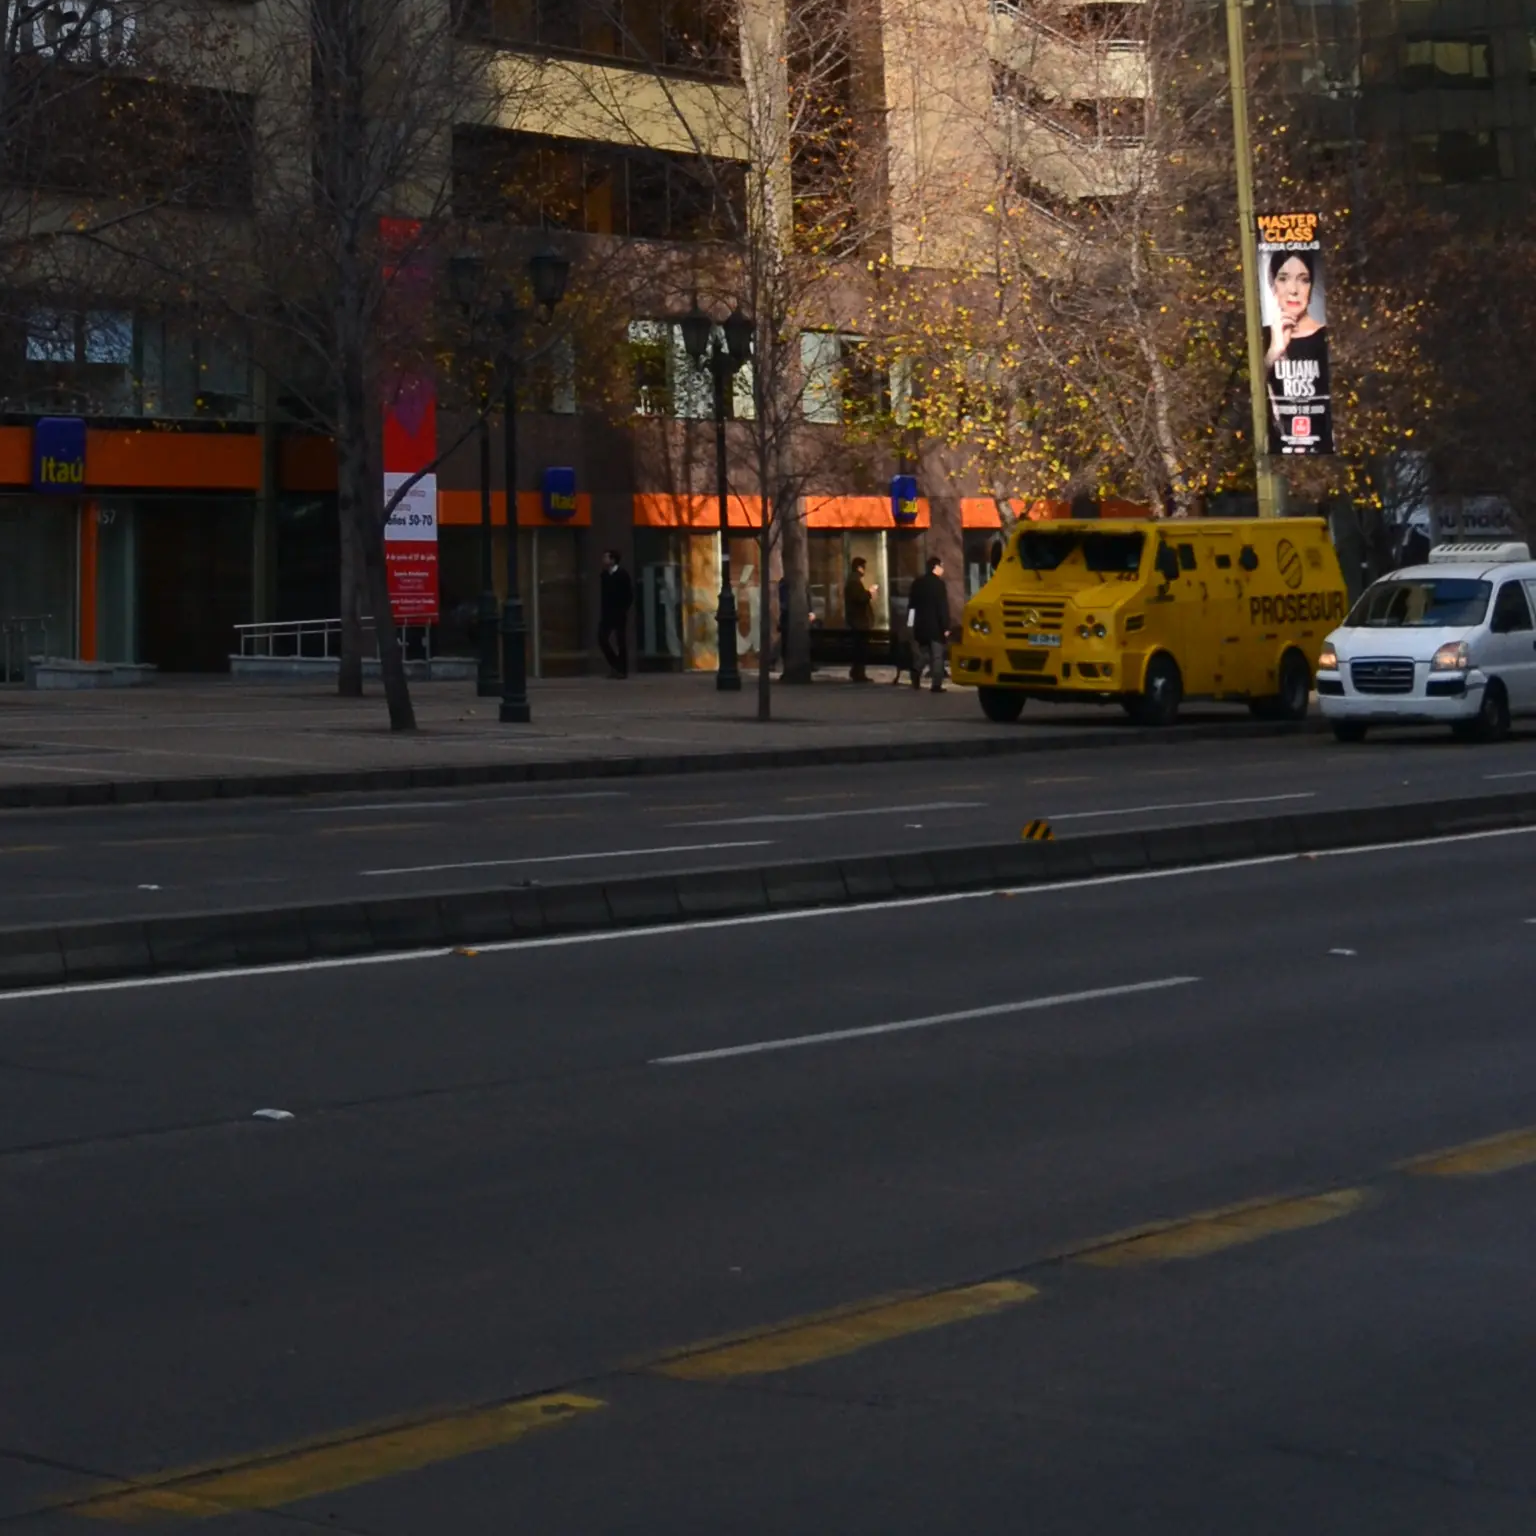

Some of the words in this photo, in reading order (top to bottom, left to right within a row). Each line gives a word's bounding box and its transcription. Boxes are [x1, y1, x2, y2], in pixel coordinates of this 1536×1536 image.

[1257, 213, 1318, 229] MASTER
[1264, 227, 1314, 242] CLASS
[1274, 359, 1321, 380] LILIANA
[1283, 378, 1316, 397] ROSS
[40, 455, 84, 484] Itaú
[408, 514, 433, 526] 50-70
[1250, 591, 1345, 626] PROSEGUR
